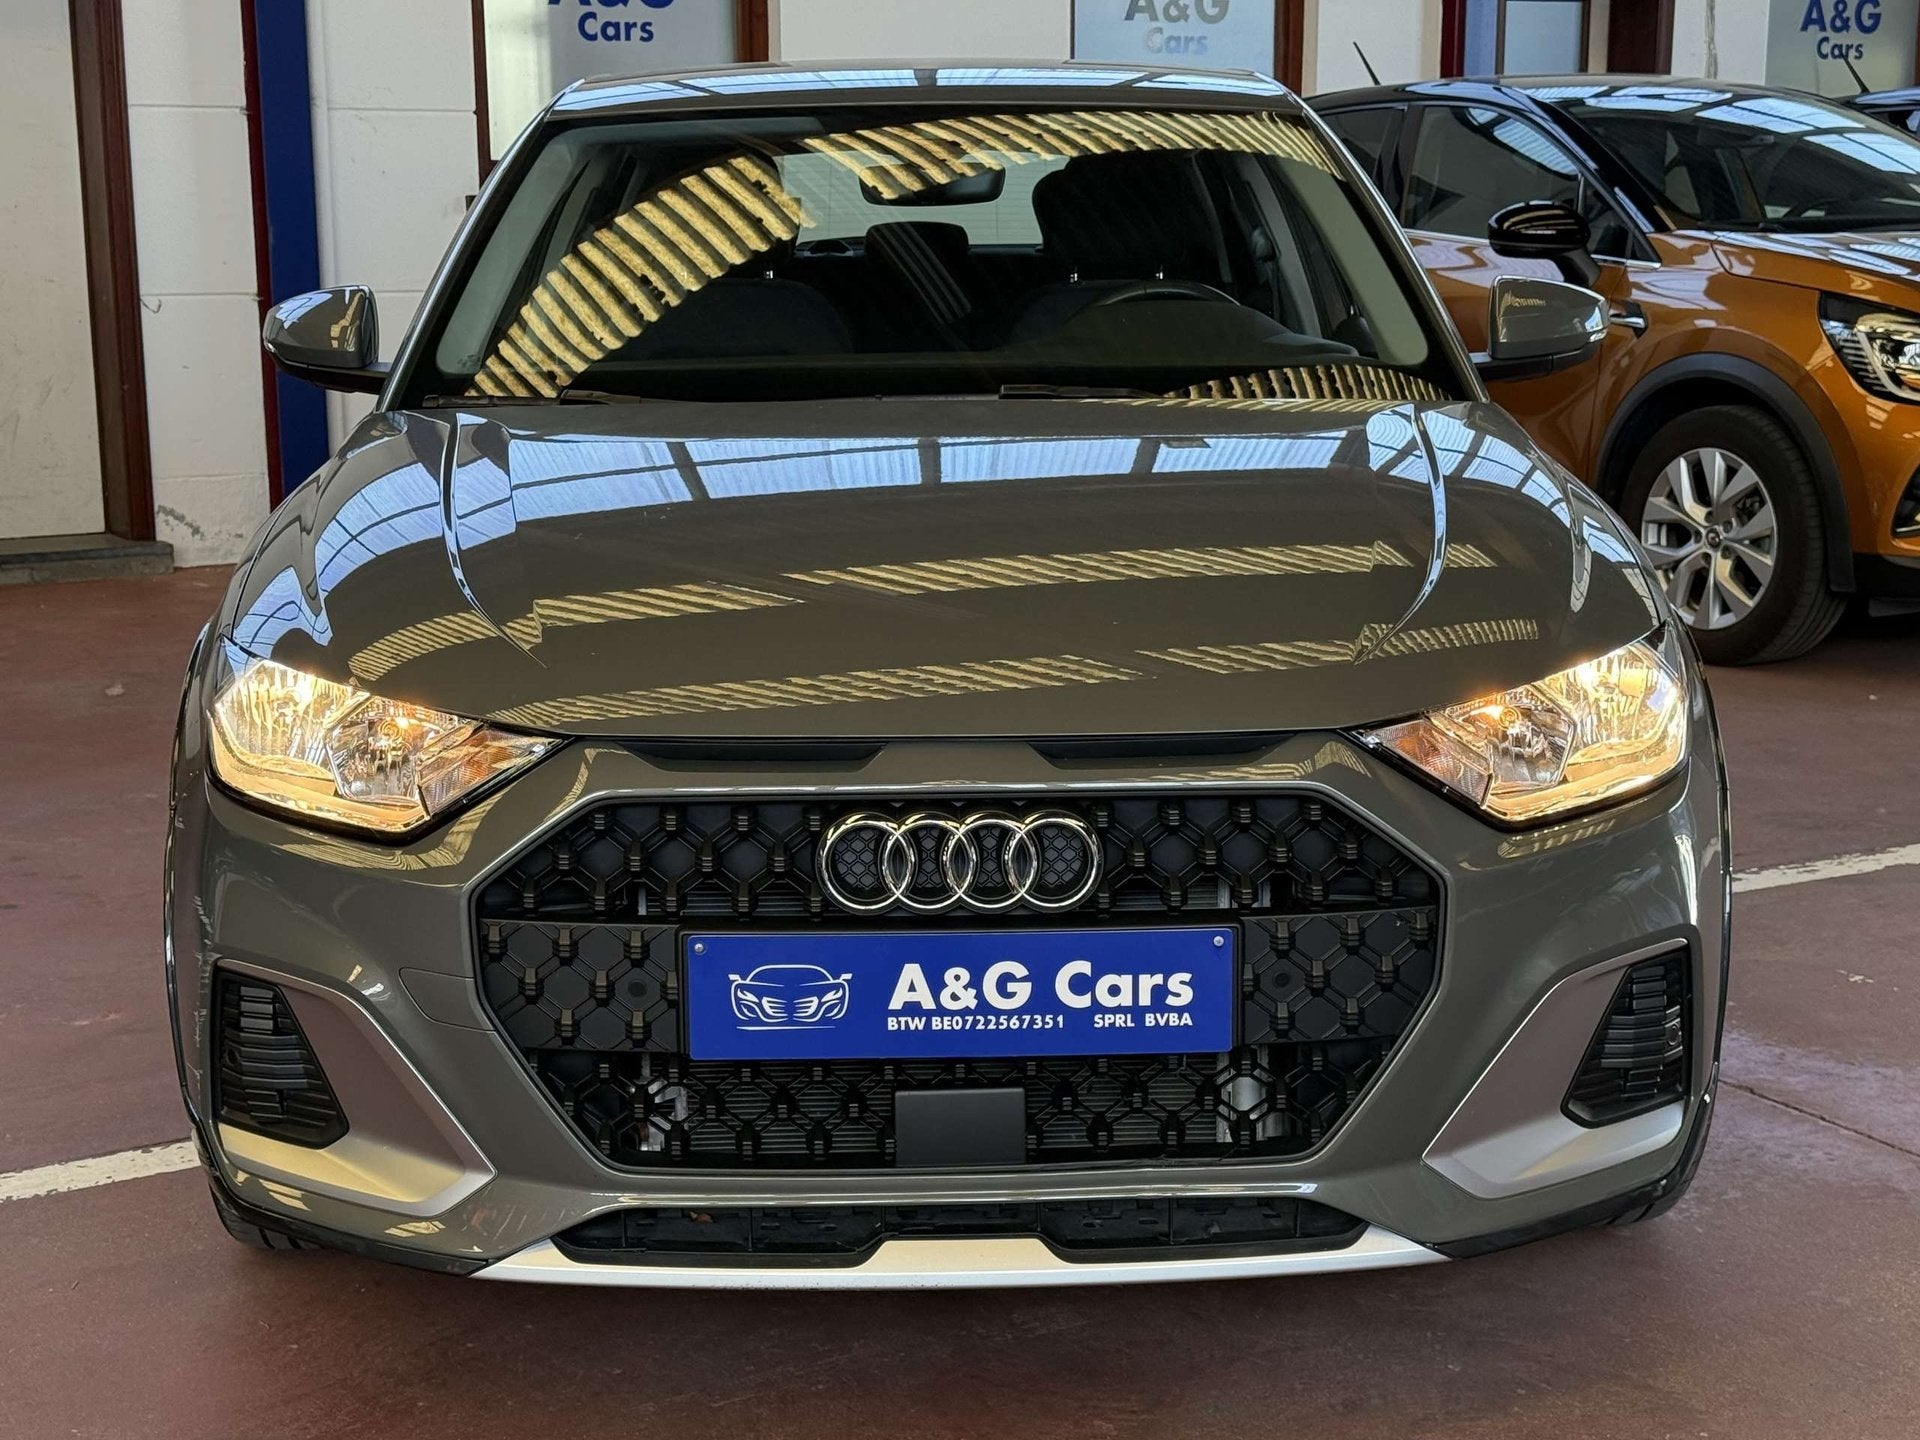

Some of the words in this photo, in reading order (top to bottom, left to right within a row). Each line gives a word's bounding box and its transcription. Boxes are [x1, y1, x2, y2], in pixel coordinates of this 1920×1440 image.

[577, 11, 654, 42] Cars
[1800, 0, 1882, 34] A&G
[1146, 26, 1208, 54] Cars
[1816, 36, 1864, 60] Cars
[887, 961, 1033, 1010] A&G
[1054, 960, 1194, 1008] Cars
[887, 1016, 926, 1031] BTW
[931, 1014, 1064, 1031] BE0722567351
[1093, 1013, 1136, 1028] SPRL
[1144, 1012, 1193, 1027] BVBA
